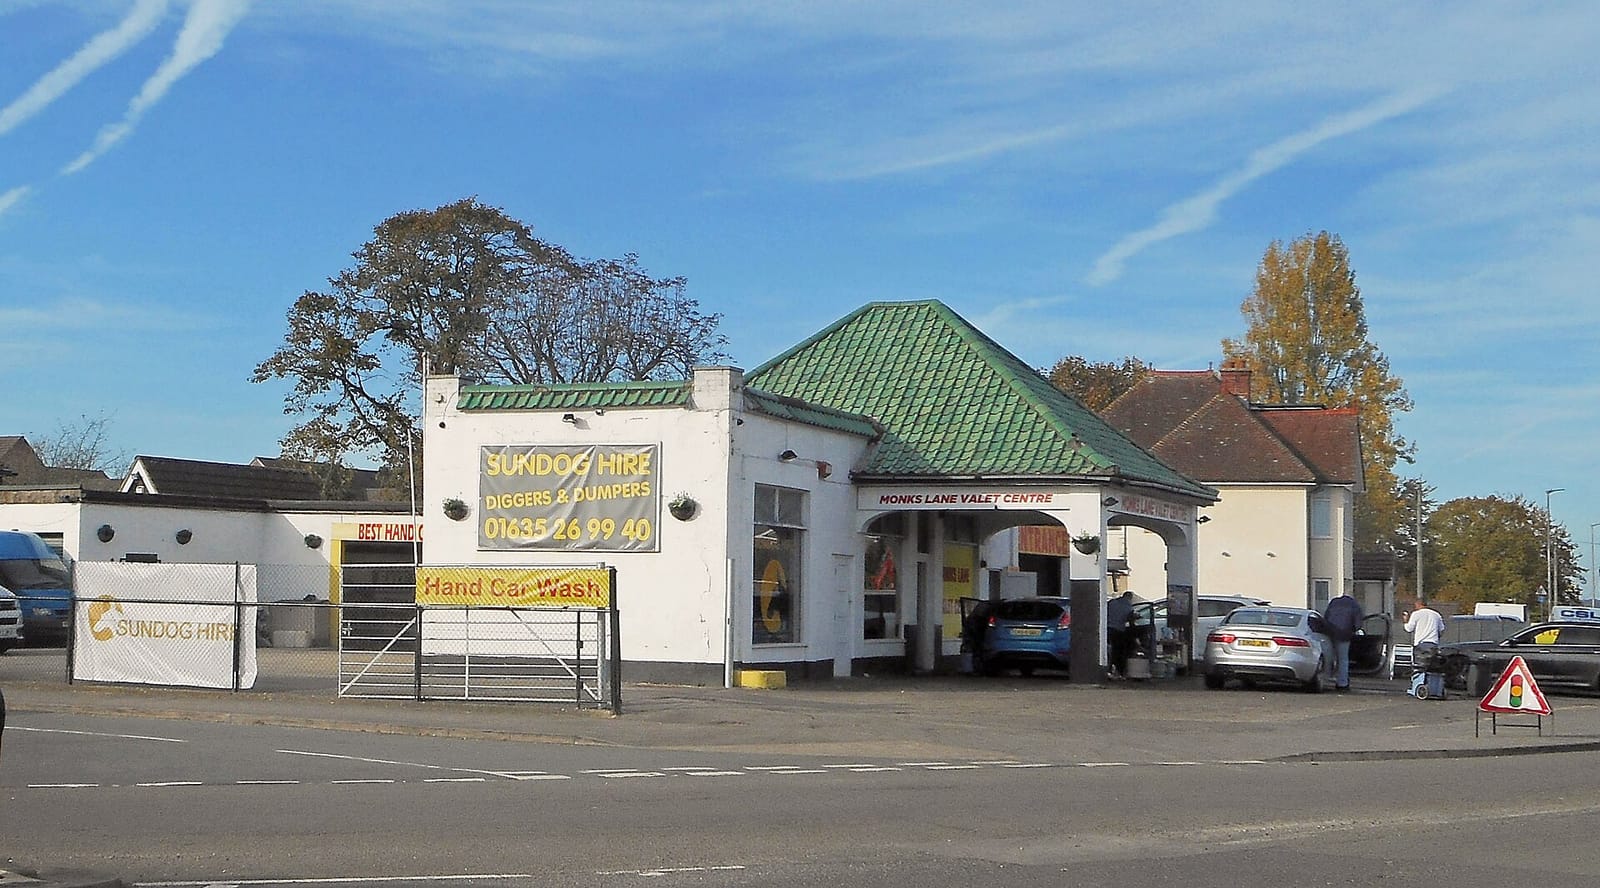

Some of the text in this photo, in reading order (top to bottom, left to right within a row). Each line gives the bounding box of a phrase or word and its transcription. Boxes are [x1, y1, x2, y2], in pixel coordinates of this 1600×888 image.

[487, 453, 651, 476] SUNDOG HIRE
[486, 481, 651, 510] DIGGERS & DUMPERS
[879, 494, 1053, 505] MONKS LANE VALET CENTRE
[358, 523, 383, 540] BEST
[384, 523, 414, 541] HAND
[484, 517, 652, 541] 01635 26 99 40
[424, 576, 601, 598] Hand Car Wash
[116, 619, 193, 640] SUNDOG
